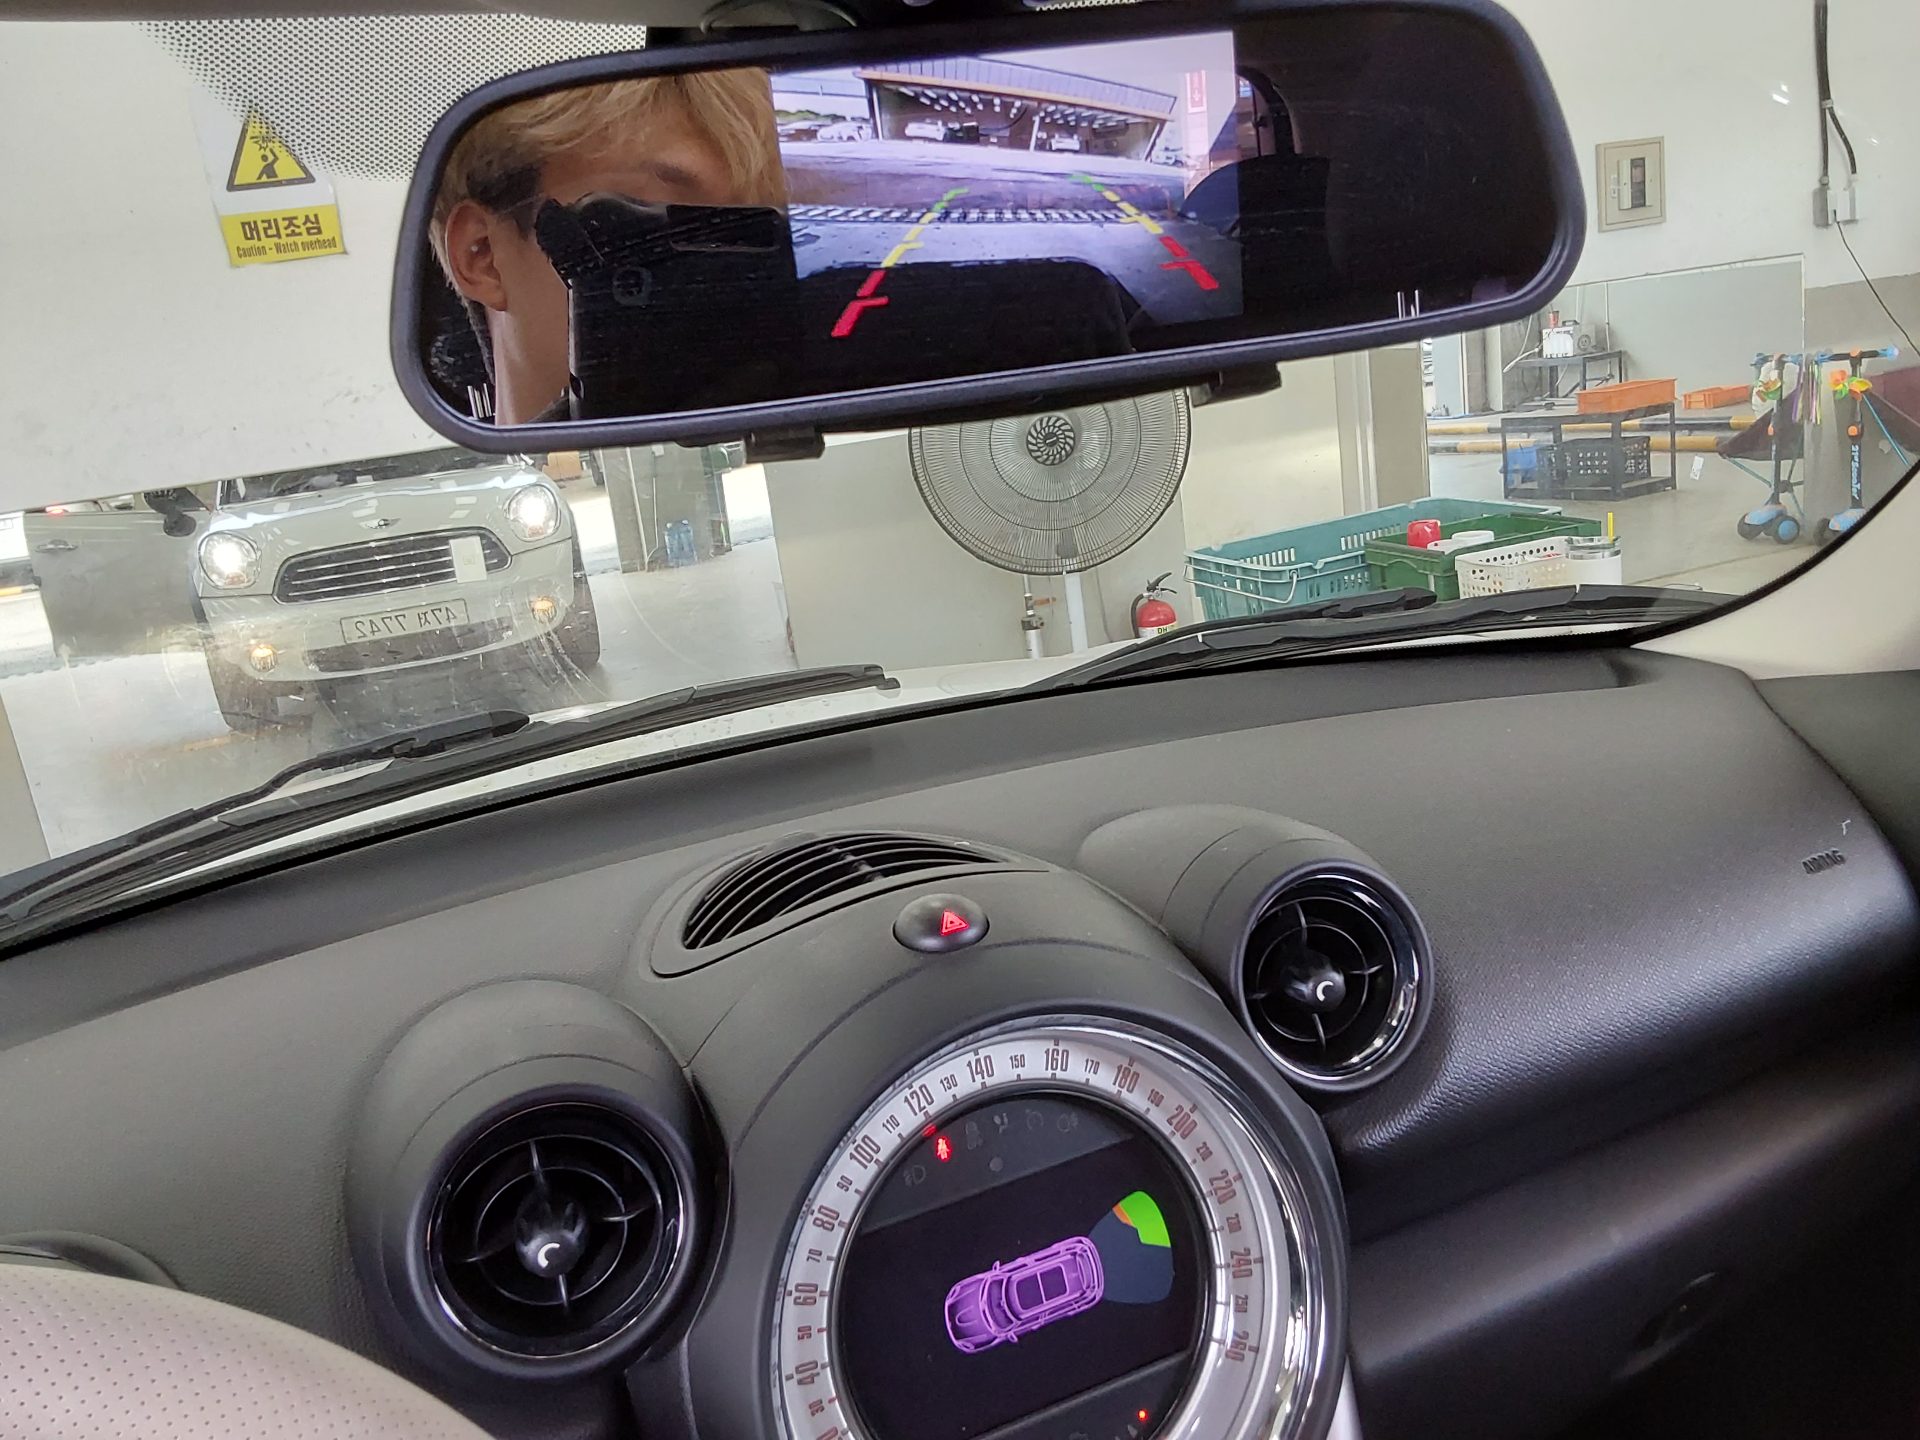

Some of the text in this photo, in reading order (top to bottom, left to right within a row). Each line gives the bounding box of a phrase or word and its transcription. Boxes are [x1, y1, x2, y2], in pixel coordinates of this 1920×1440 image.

[241, 214, 323, 241] 머리조심
[237, 243, 267, 258] Caution
[276, 241, 300, 254] Watch
[301, 237, 337, 253] overhead
[967, 1055, 995, 1083] 140
[1009, 1054, 1026, 1069] 150
[1045, 1048, 1069, 1072] 160
[1084, 1058, 1100, 1075] 170
[940, 1074, 958, 1092] 130
[1112, 1064, 1140, 1094] 180
[904, 1084, 934, 1116] 120
[882, 1114, 900, 1134] 110
[1166, 1104, 1198, 1140] 200
[850, 1134, 881, 1169] 100
[837, 1175, 853, 1192] 90
[1209, 1169, 1237, 1205] 220
[812, 1205, 840, 1232] 80
[806, 1249, 822, 1263] 70
[1231, 1247, 1253, 1279] 240
[793, 1283, 818, 1306] 60
[1225, 1330, 1249, 1362] 260
[795, 1360, 820, 1386] 40
